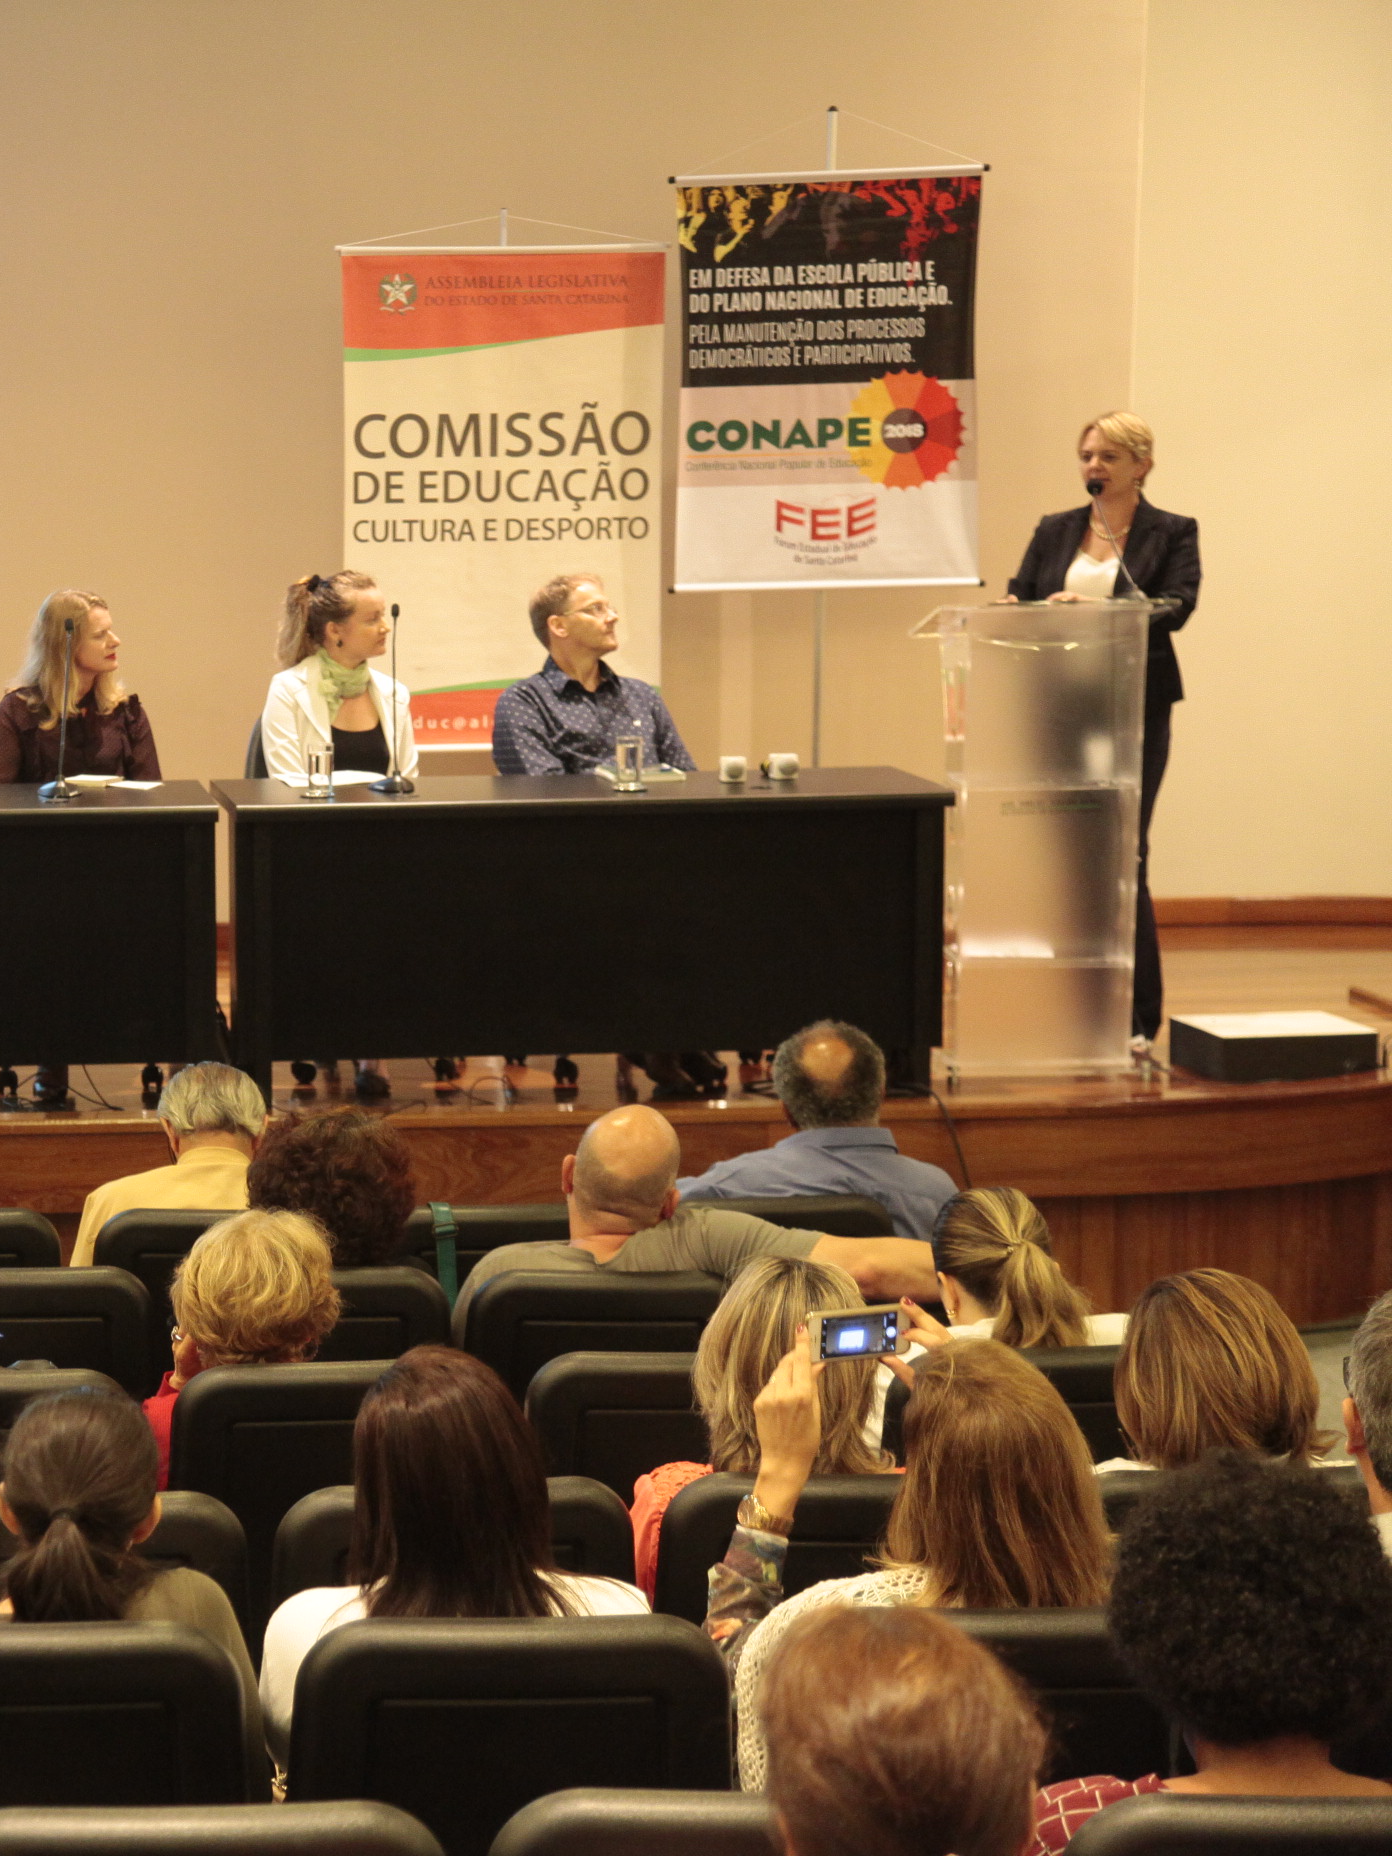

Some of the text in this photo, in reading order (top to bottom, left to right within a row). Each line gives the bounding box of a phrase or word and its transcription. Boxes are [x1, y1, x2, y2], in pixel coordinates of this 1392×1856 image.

[424, 274, 629, 289] ASSEMBLEIA LEGISLATIVA
[689, 258, 935, 288] EM DEFESA DA ESCOLA PÚBLICA E
[689, 281, 954, 314] DO PLANO NACIONAL DE EDUCAÇÃO.
[689, 316, 926, 348] PELA MANUTENÇÃO DOS PROCESSOS
[689, 342, 916, 369] DEMOCRÁTICOS E PARTICIPATIVOS.
[354, 402, 651, 459] COMISSÃO
[687, 418, 872, 452] CONAPE
[353, 461, 650, 512] DE EDUCAÇÃO
[353, 516, 650, 543] CULTURA E DESPORTO
[775, 498, 877, 541] FEE
[413, 714, 495, 731] duc@al
